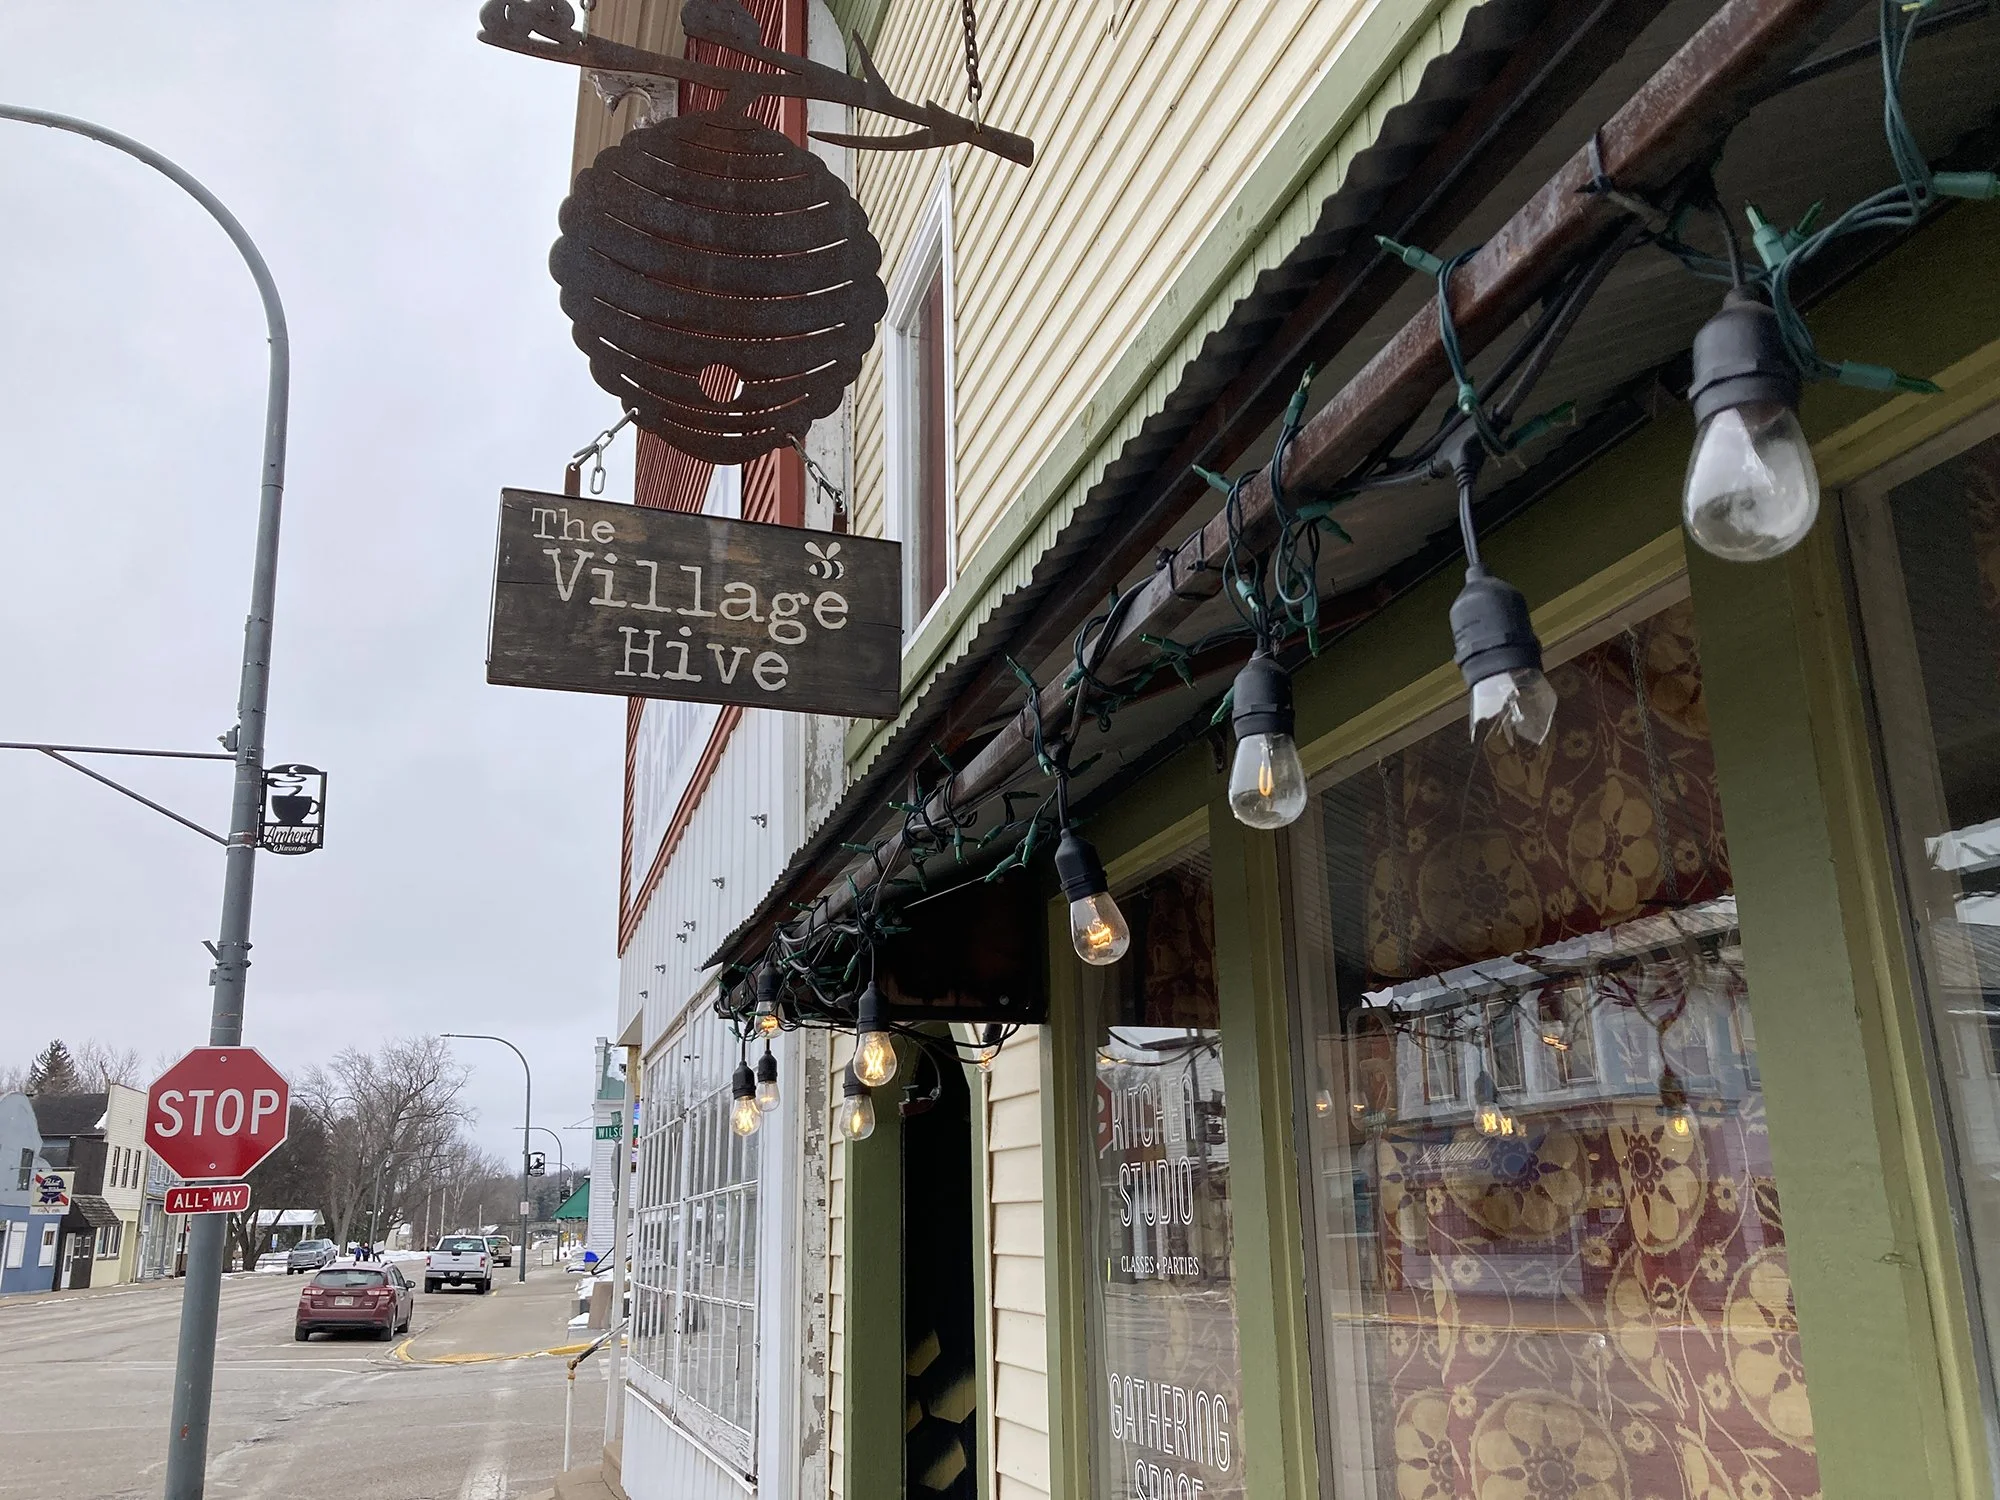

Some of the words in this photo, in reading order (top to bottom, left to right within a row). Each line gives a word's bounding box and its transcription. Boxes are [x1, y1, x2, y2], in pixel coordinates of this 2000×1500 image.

[531, 507, 616, 544] The
[543, 548, 849, 645] Village
[614, 626, 789, 692] Hive
[154, 1088, 280, 1138] STOP
[598, 1127, 623, 1138] WILSO
[1111, 1073, 1196, 1151] KITCHEN
[173, 1190, 242, 1209] ALL-WAY
[1119, 1156, 1193, 1227] STUDIO
[1121, 1255, 1154, 1273] CLASSES
[1162, 1256, 1199, 1275] PARTIES
[1110, 1373, 1231, 1472] GATHERING
